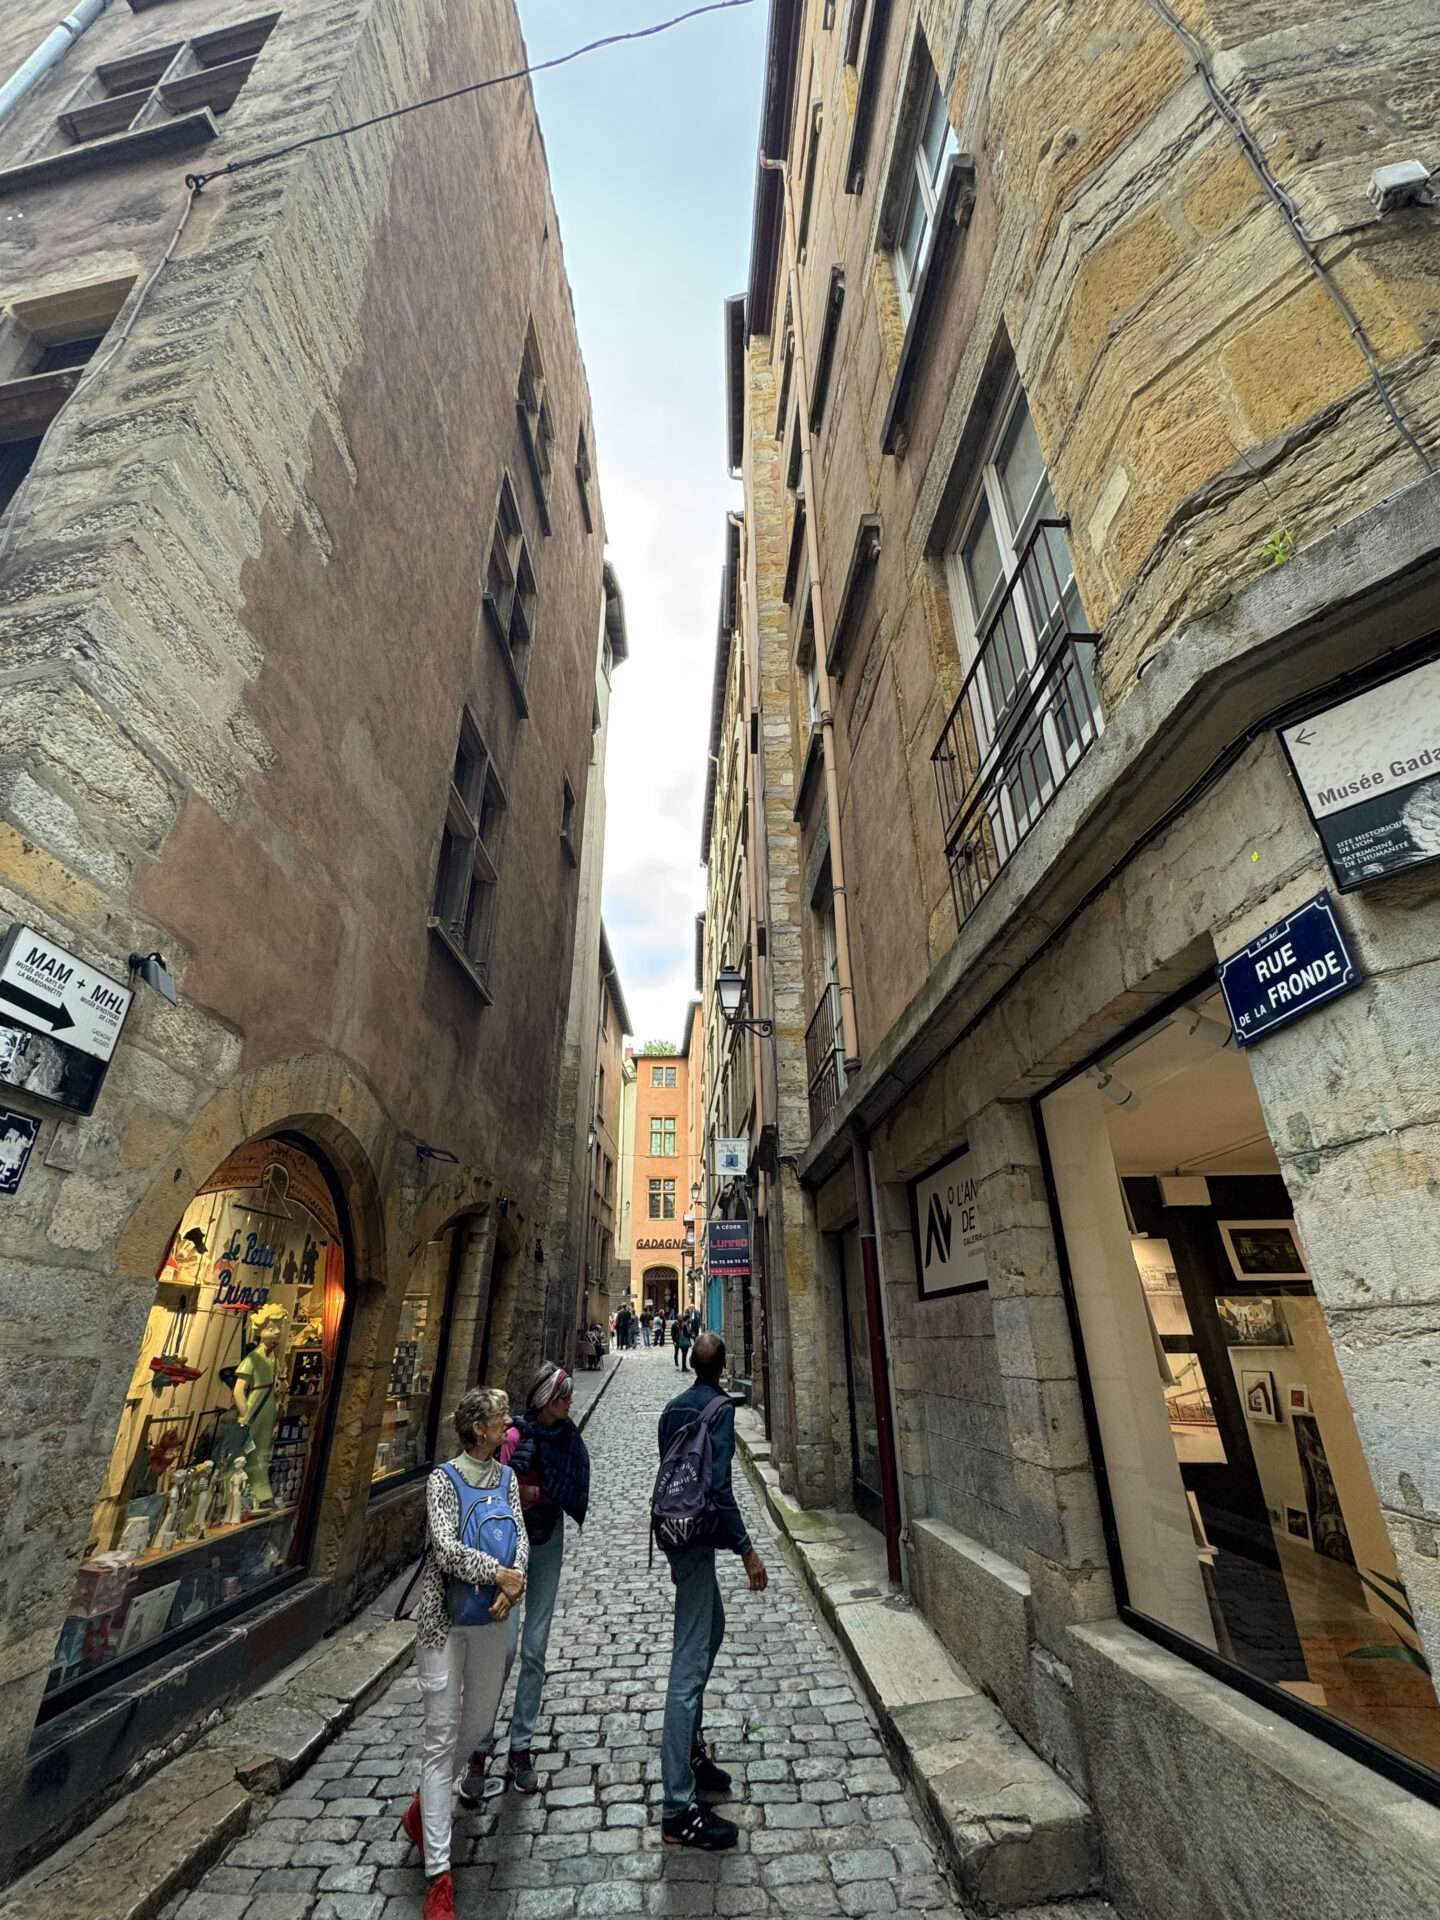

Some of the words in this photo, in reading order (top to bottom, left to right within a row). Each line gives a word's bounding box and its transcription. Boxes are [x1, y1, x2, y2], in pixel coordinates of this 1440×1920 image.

[1317, 774, 1385, 806] Musée
[1336, 837, 1354, 849] SITE
[1338, 845, 1350, 855] DE
[1352, 838, 1374, 851] LYON
[1342, 840, 1393, 863] PATRIMOINE
[1344, 859, 1356, 868] DE
[1255, 942, 1297, 983] RUE
[25, 947, 74, 984] MAM
[90, 984, 125, 1015] MHL
[1239, 1012, 1252, 1028] DE
[1254, 1004, 1267, 1019] LA
[1267, 950, 1341, 1009] FRONDE
[222, 1229, 242, 1260] Le
[636, 1239, 687, 1249] GADAGNE
